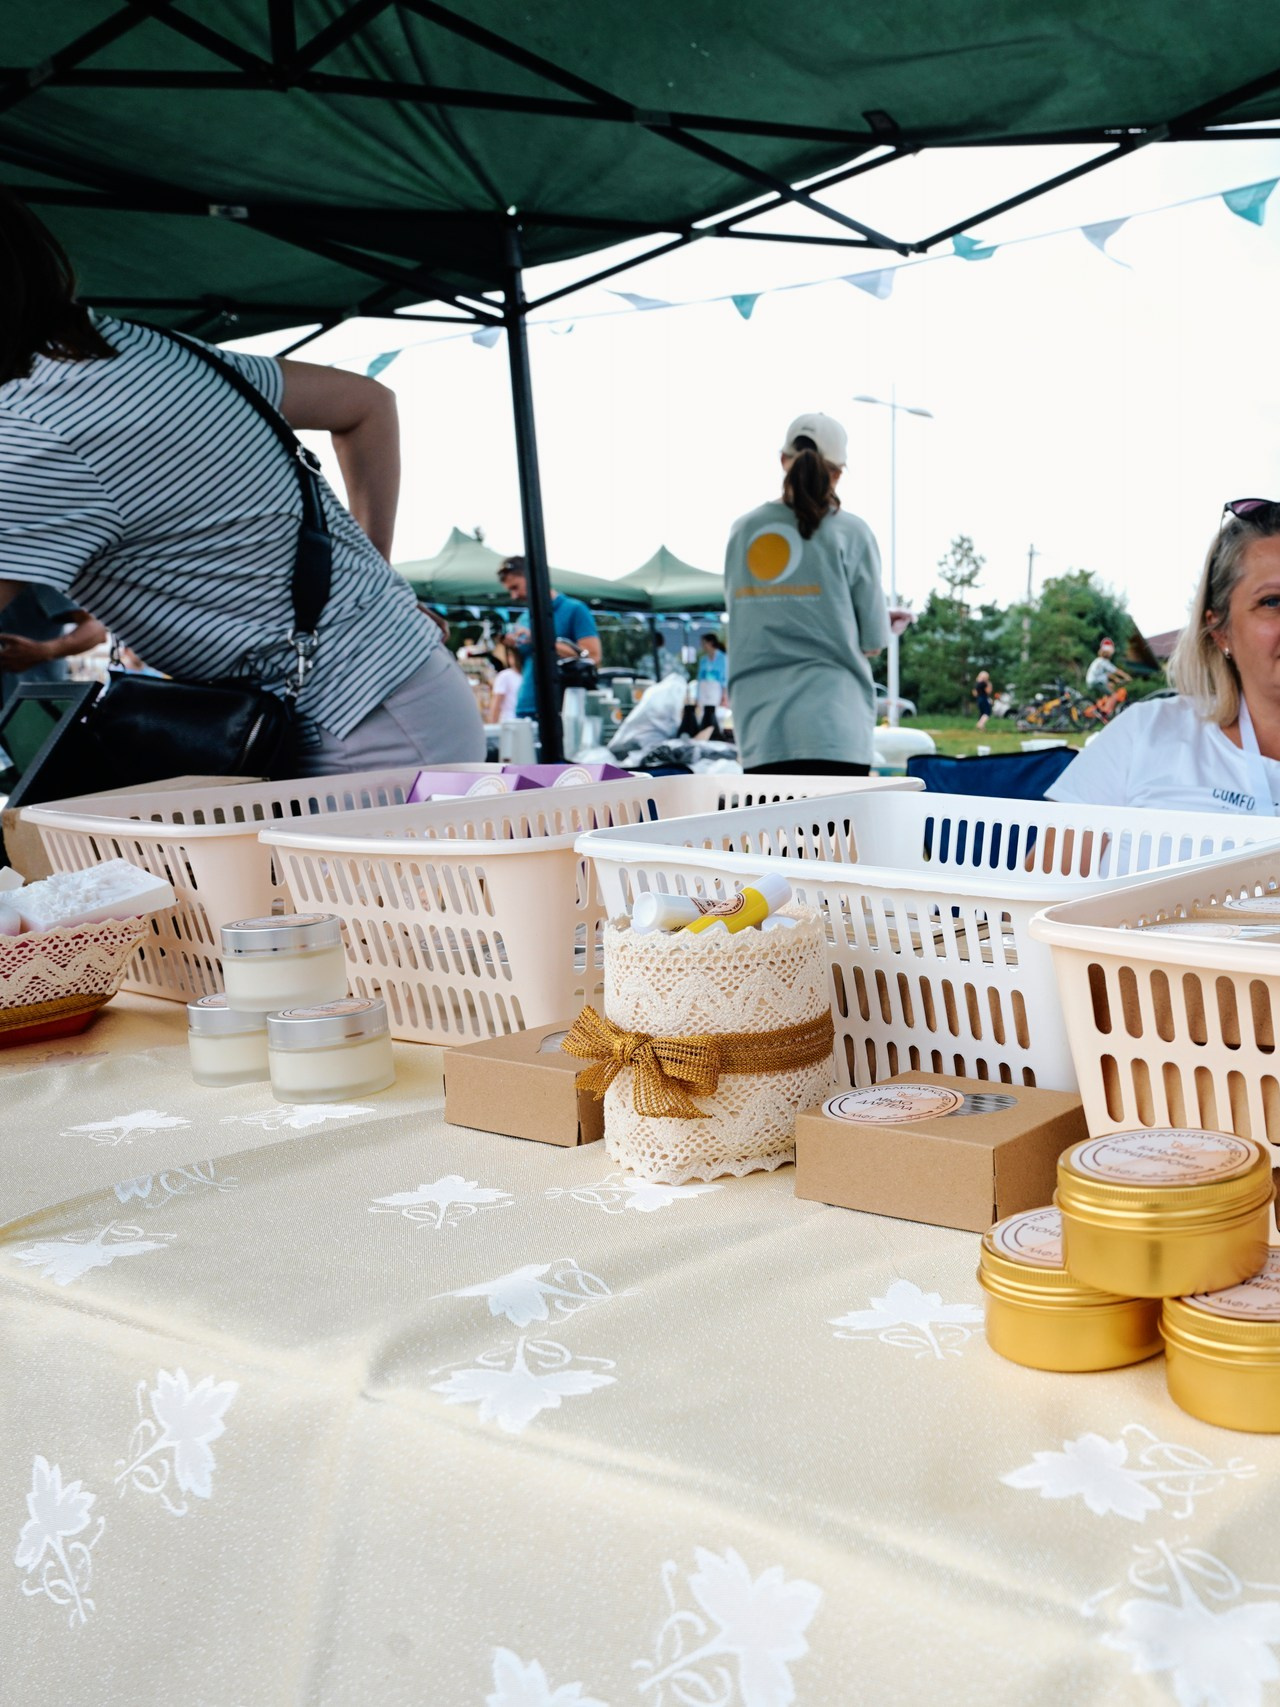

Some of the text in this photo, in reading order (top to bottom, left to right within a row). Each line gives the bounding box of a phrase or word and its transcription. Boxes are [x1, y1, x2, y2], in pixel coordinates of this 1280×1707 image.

[875, 1097, 914, 1105] МЫЛО
[884, 1102, 913, 1111] ТЕЛА
[1111, 1132, 1215, 1145] НАТУРАЛЬНАЯ
